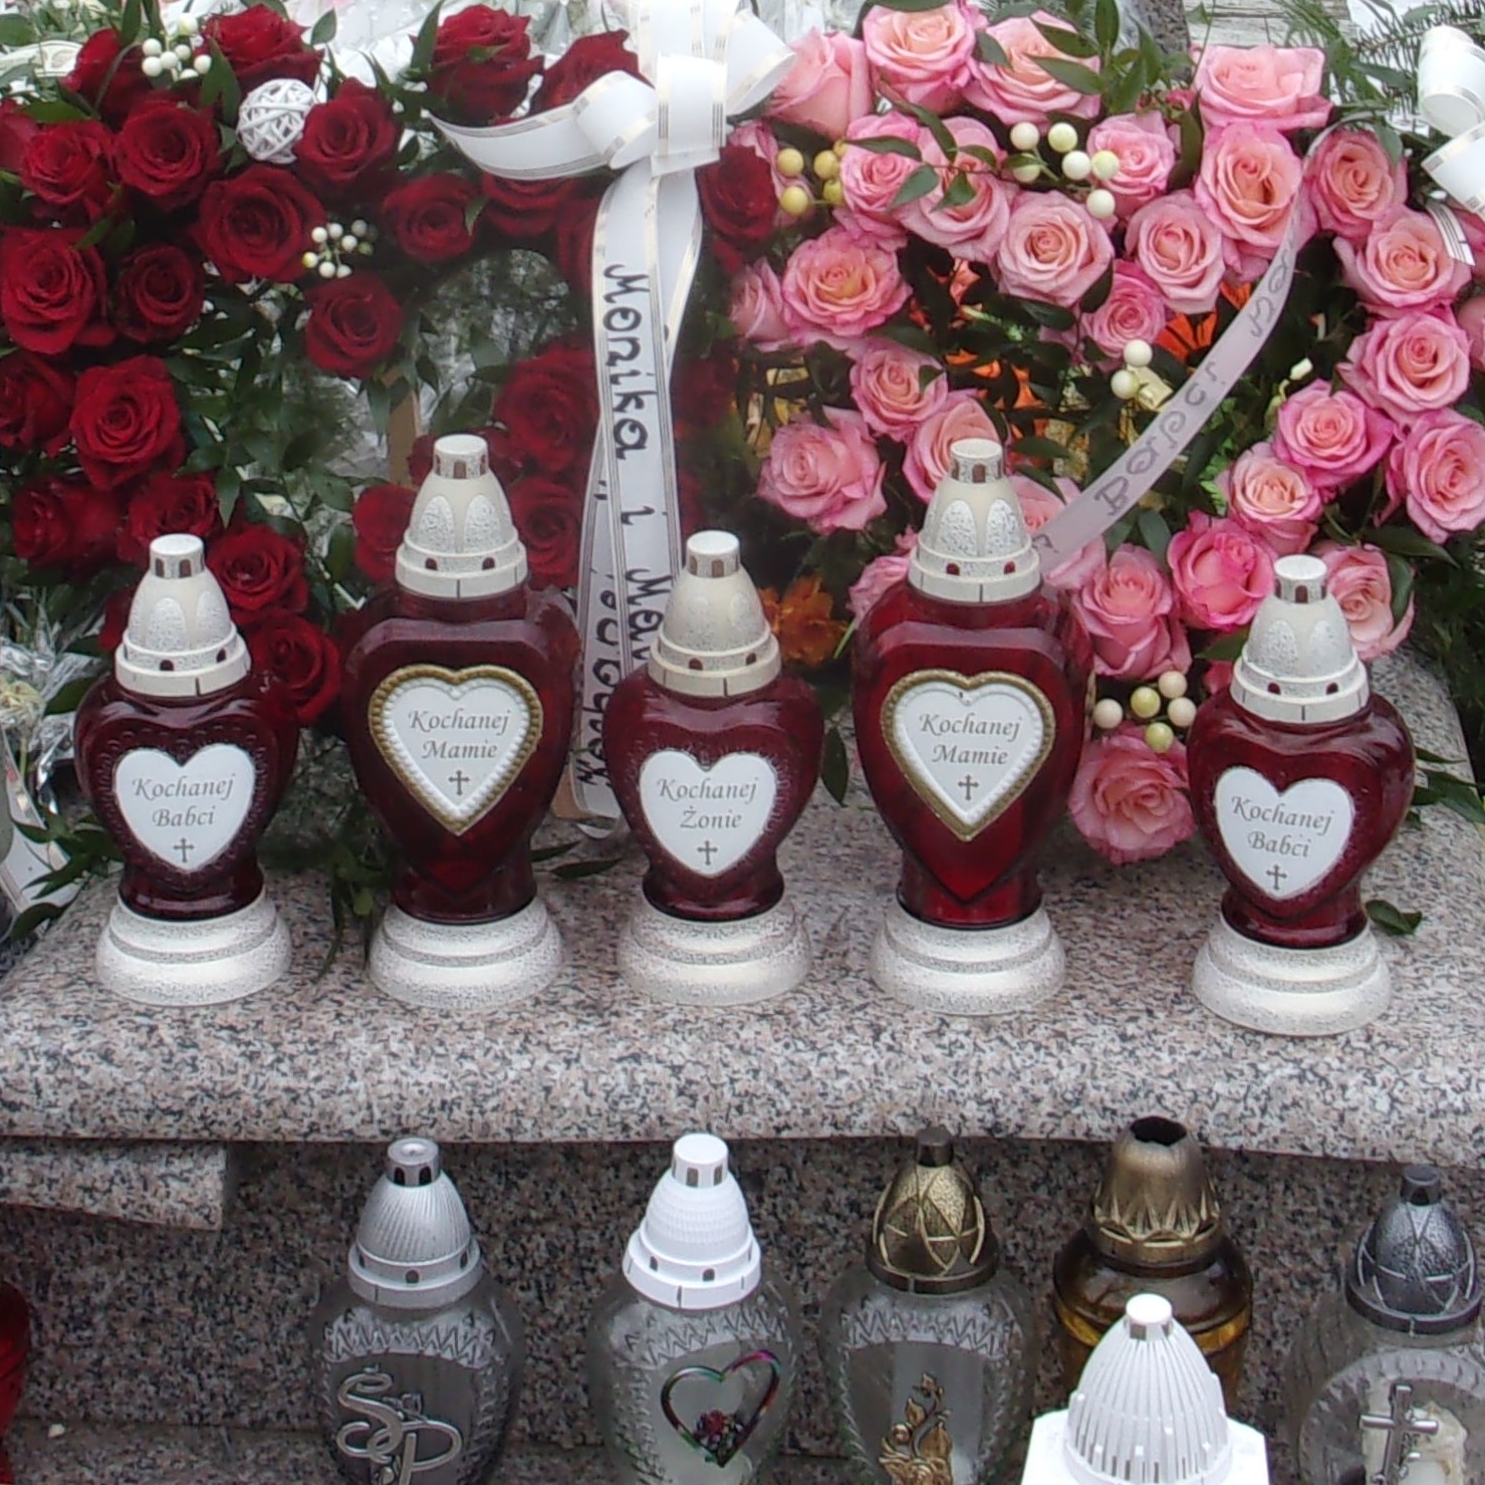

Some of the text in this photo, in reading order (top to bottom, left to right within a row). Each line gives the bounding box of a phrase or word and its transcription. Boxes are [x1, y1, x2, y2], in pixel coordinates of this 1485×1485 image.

[601, 262, 656, 461] Monika
[408, 708, 512, 736] Kochanej
[919, 711, 1024, 738] Kochanej
[421, 737, 499, 760] Mamie
[931, 743, 1009, 767] Mamie
[131, 772, 236, 802] Kochanej
[656, 776, 758, 804] Kochanej
[152, 803, 216, 828] Babci
[680, 805, 743, 830] Żonie
[1229, 793, 1334, 836] Kochanej
[1247, 829, 1311, 860] Babci
